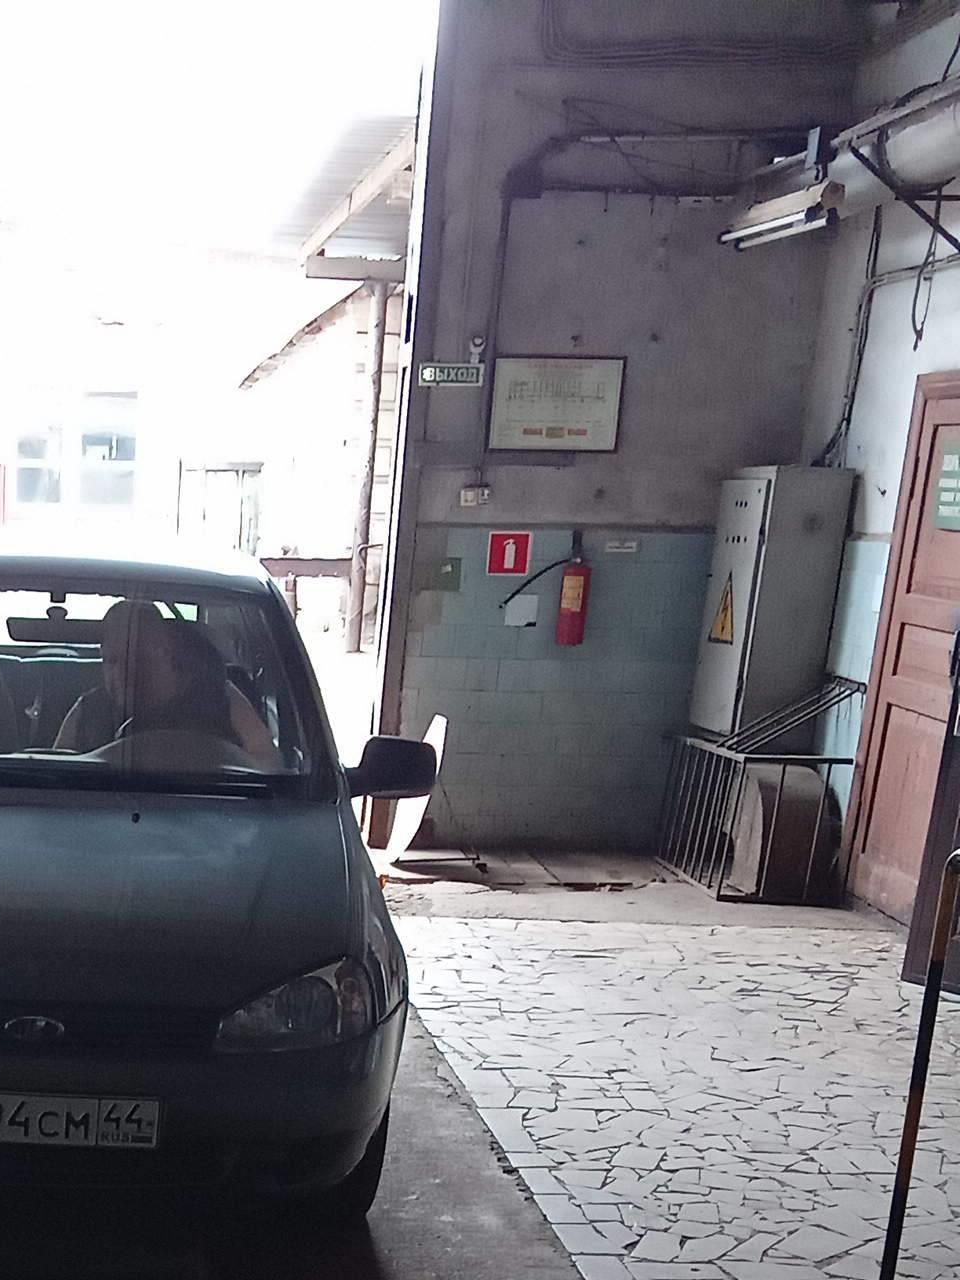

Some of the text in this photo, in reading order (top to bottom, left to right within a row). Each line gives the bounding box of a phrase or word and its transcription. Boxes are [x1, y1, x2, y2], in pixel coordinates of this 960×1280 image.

[423, 367, 477, 382] ВЫХОД
[103, 1103, 142, 1130] 44
[101, 1131, 131, 1143] RUS
